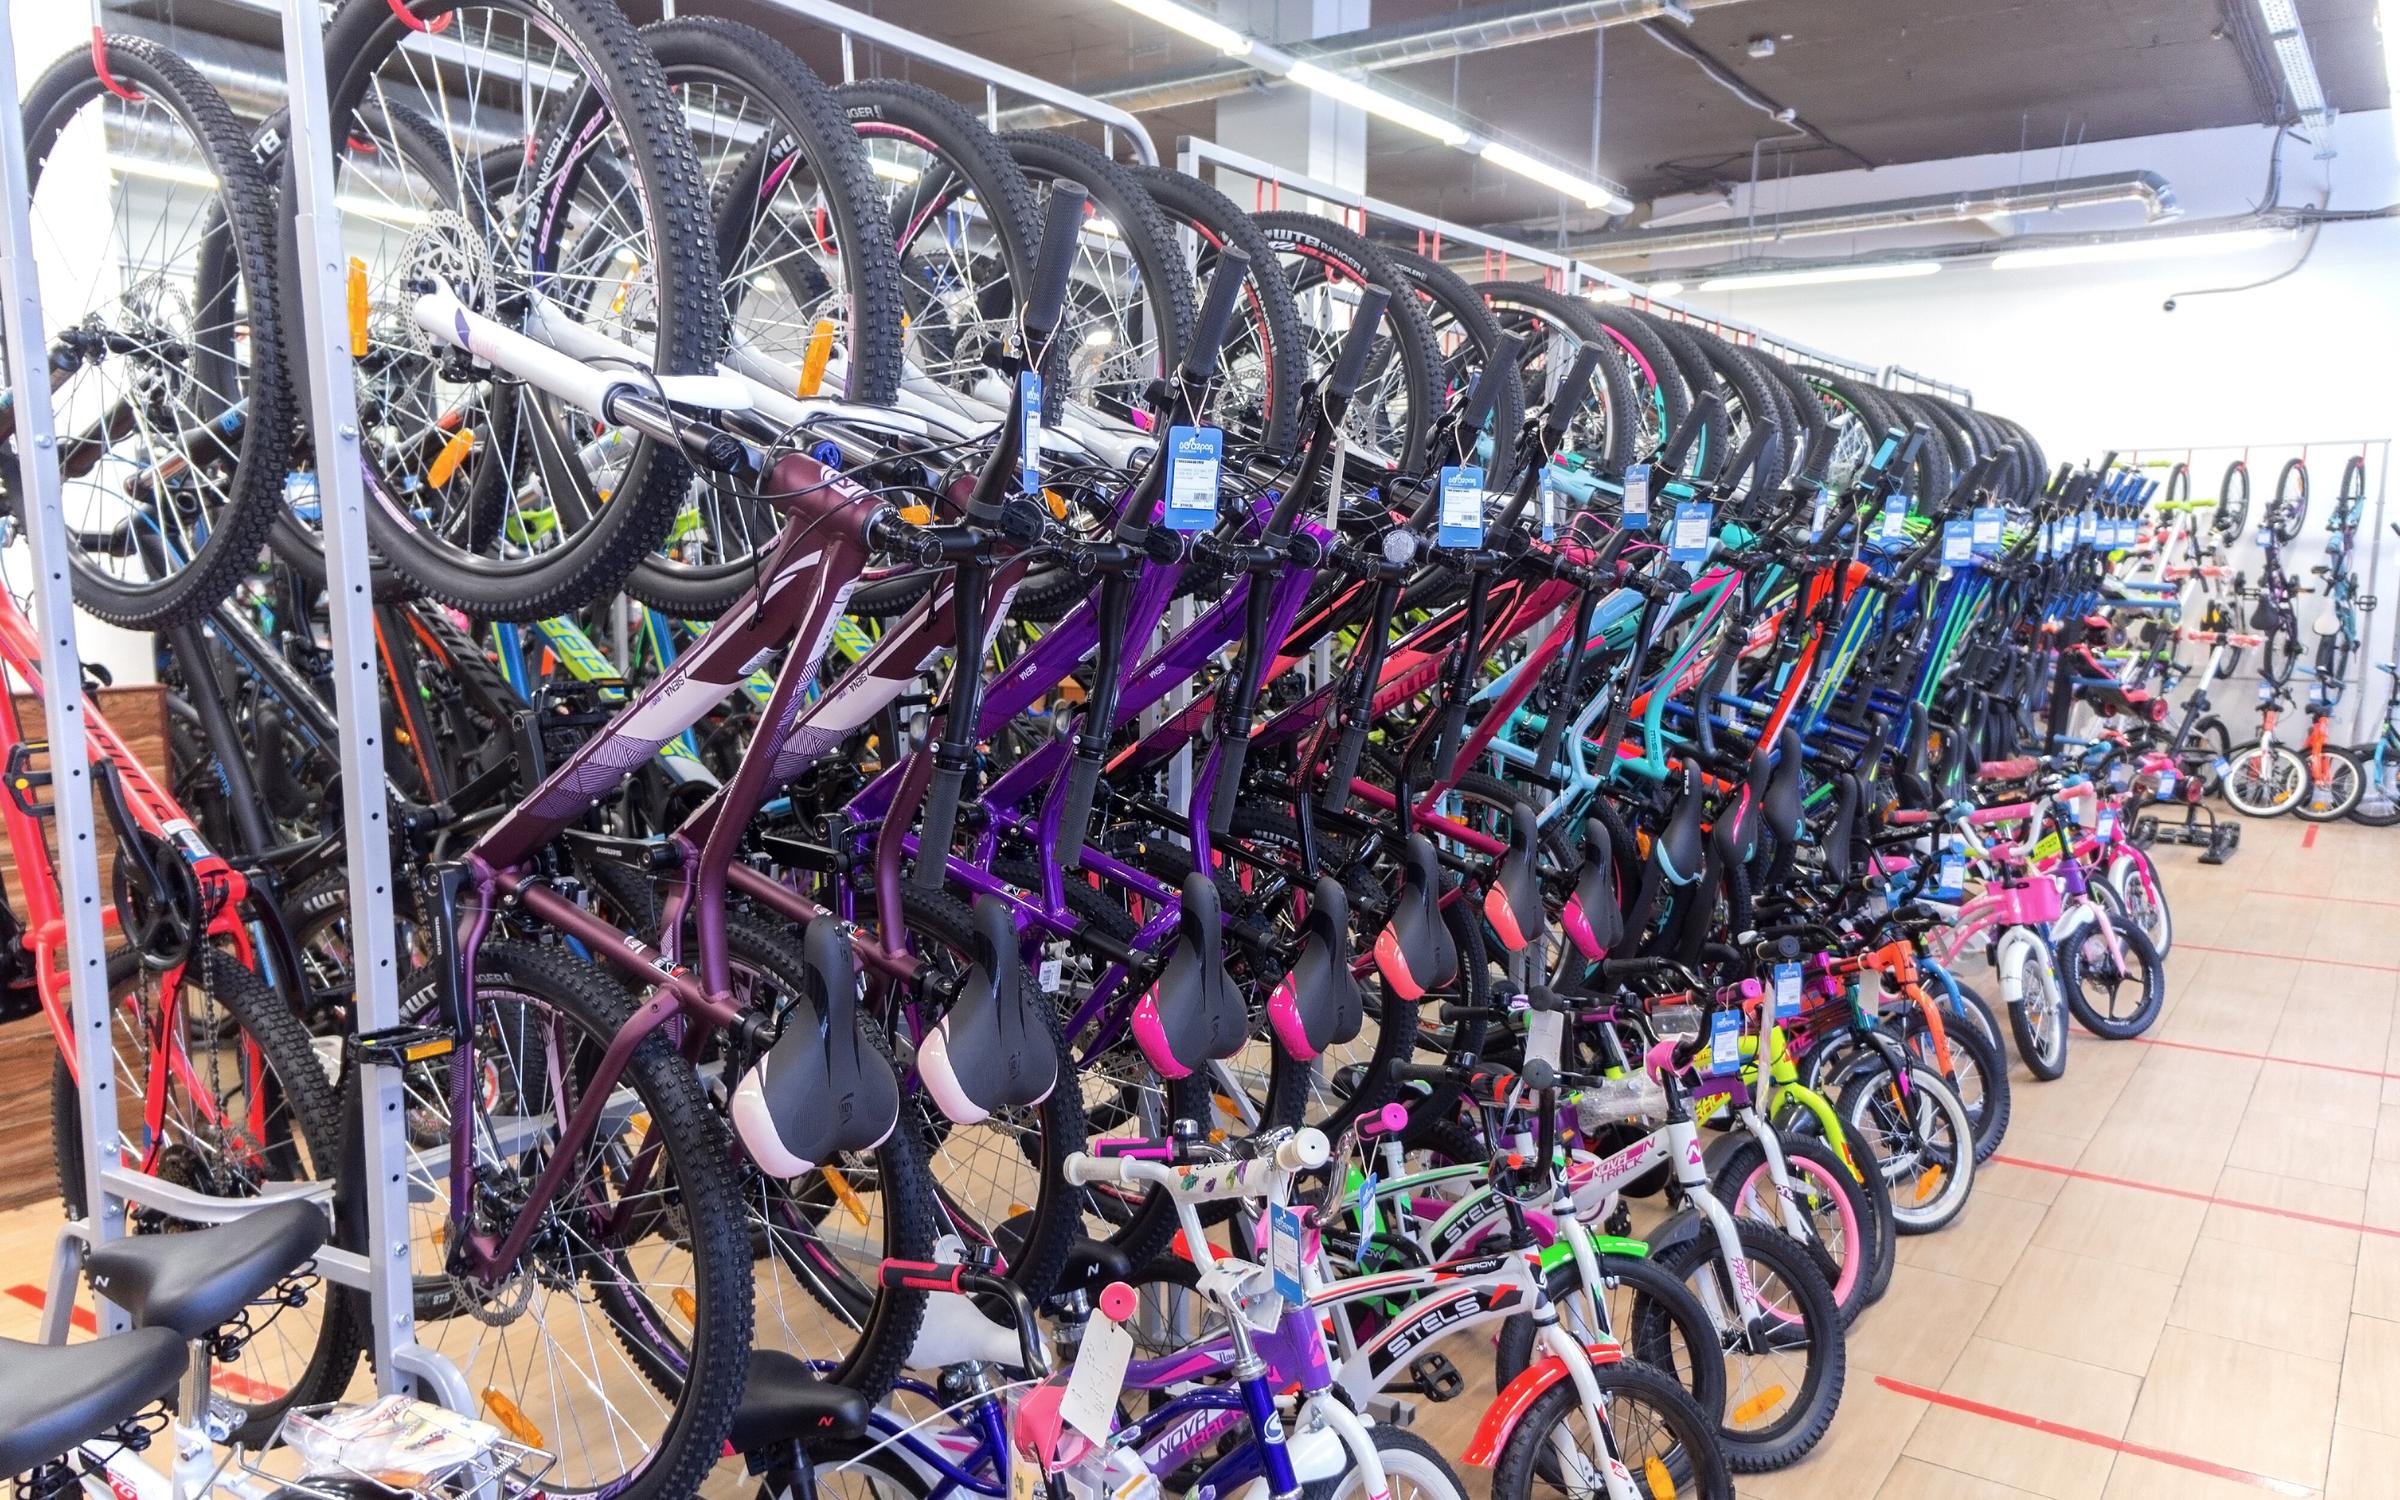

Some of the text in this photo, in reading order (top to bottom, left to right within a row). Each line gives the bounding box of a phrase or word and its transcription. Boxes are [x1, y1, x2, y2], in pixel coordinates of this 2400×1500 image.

[251, 128, 282, 164] TB
[1273, 229, 1362, 270] WTB RANGER
[848, 673, 868, 692] SIENA
[1018, 662, 1037, 681] SIENA
[1149, 662, 1167, 680] SIENA
[663, 676, 685, 698] SIENA
[1649, 729, 1659, 762] MISS
[596, 846, 622, 858] SHIMANO
[311, 888, 346, 910] WT
[1592, 1153, 1628, 1178] NOVA
[1600, 1154, 1643, 1184] TRACK
[1456, 1258, 1497, 1273] ARROW
[95, 1275, 109, 1288] N
[1731, 1256, 1752, 1307] TRACK
[1387, 1296, 1481, 1359] STELS
[1157, 1410, 1209, 1460] NOVA
